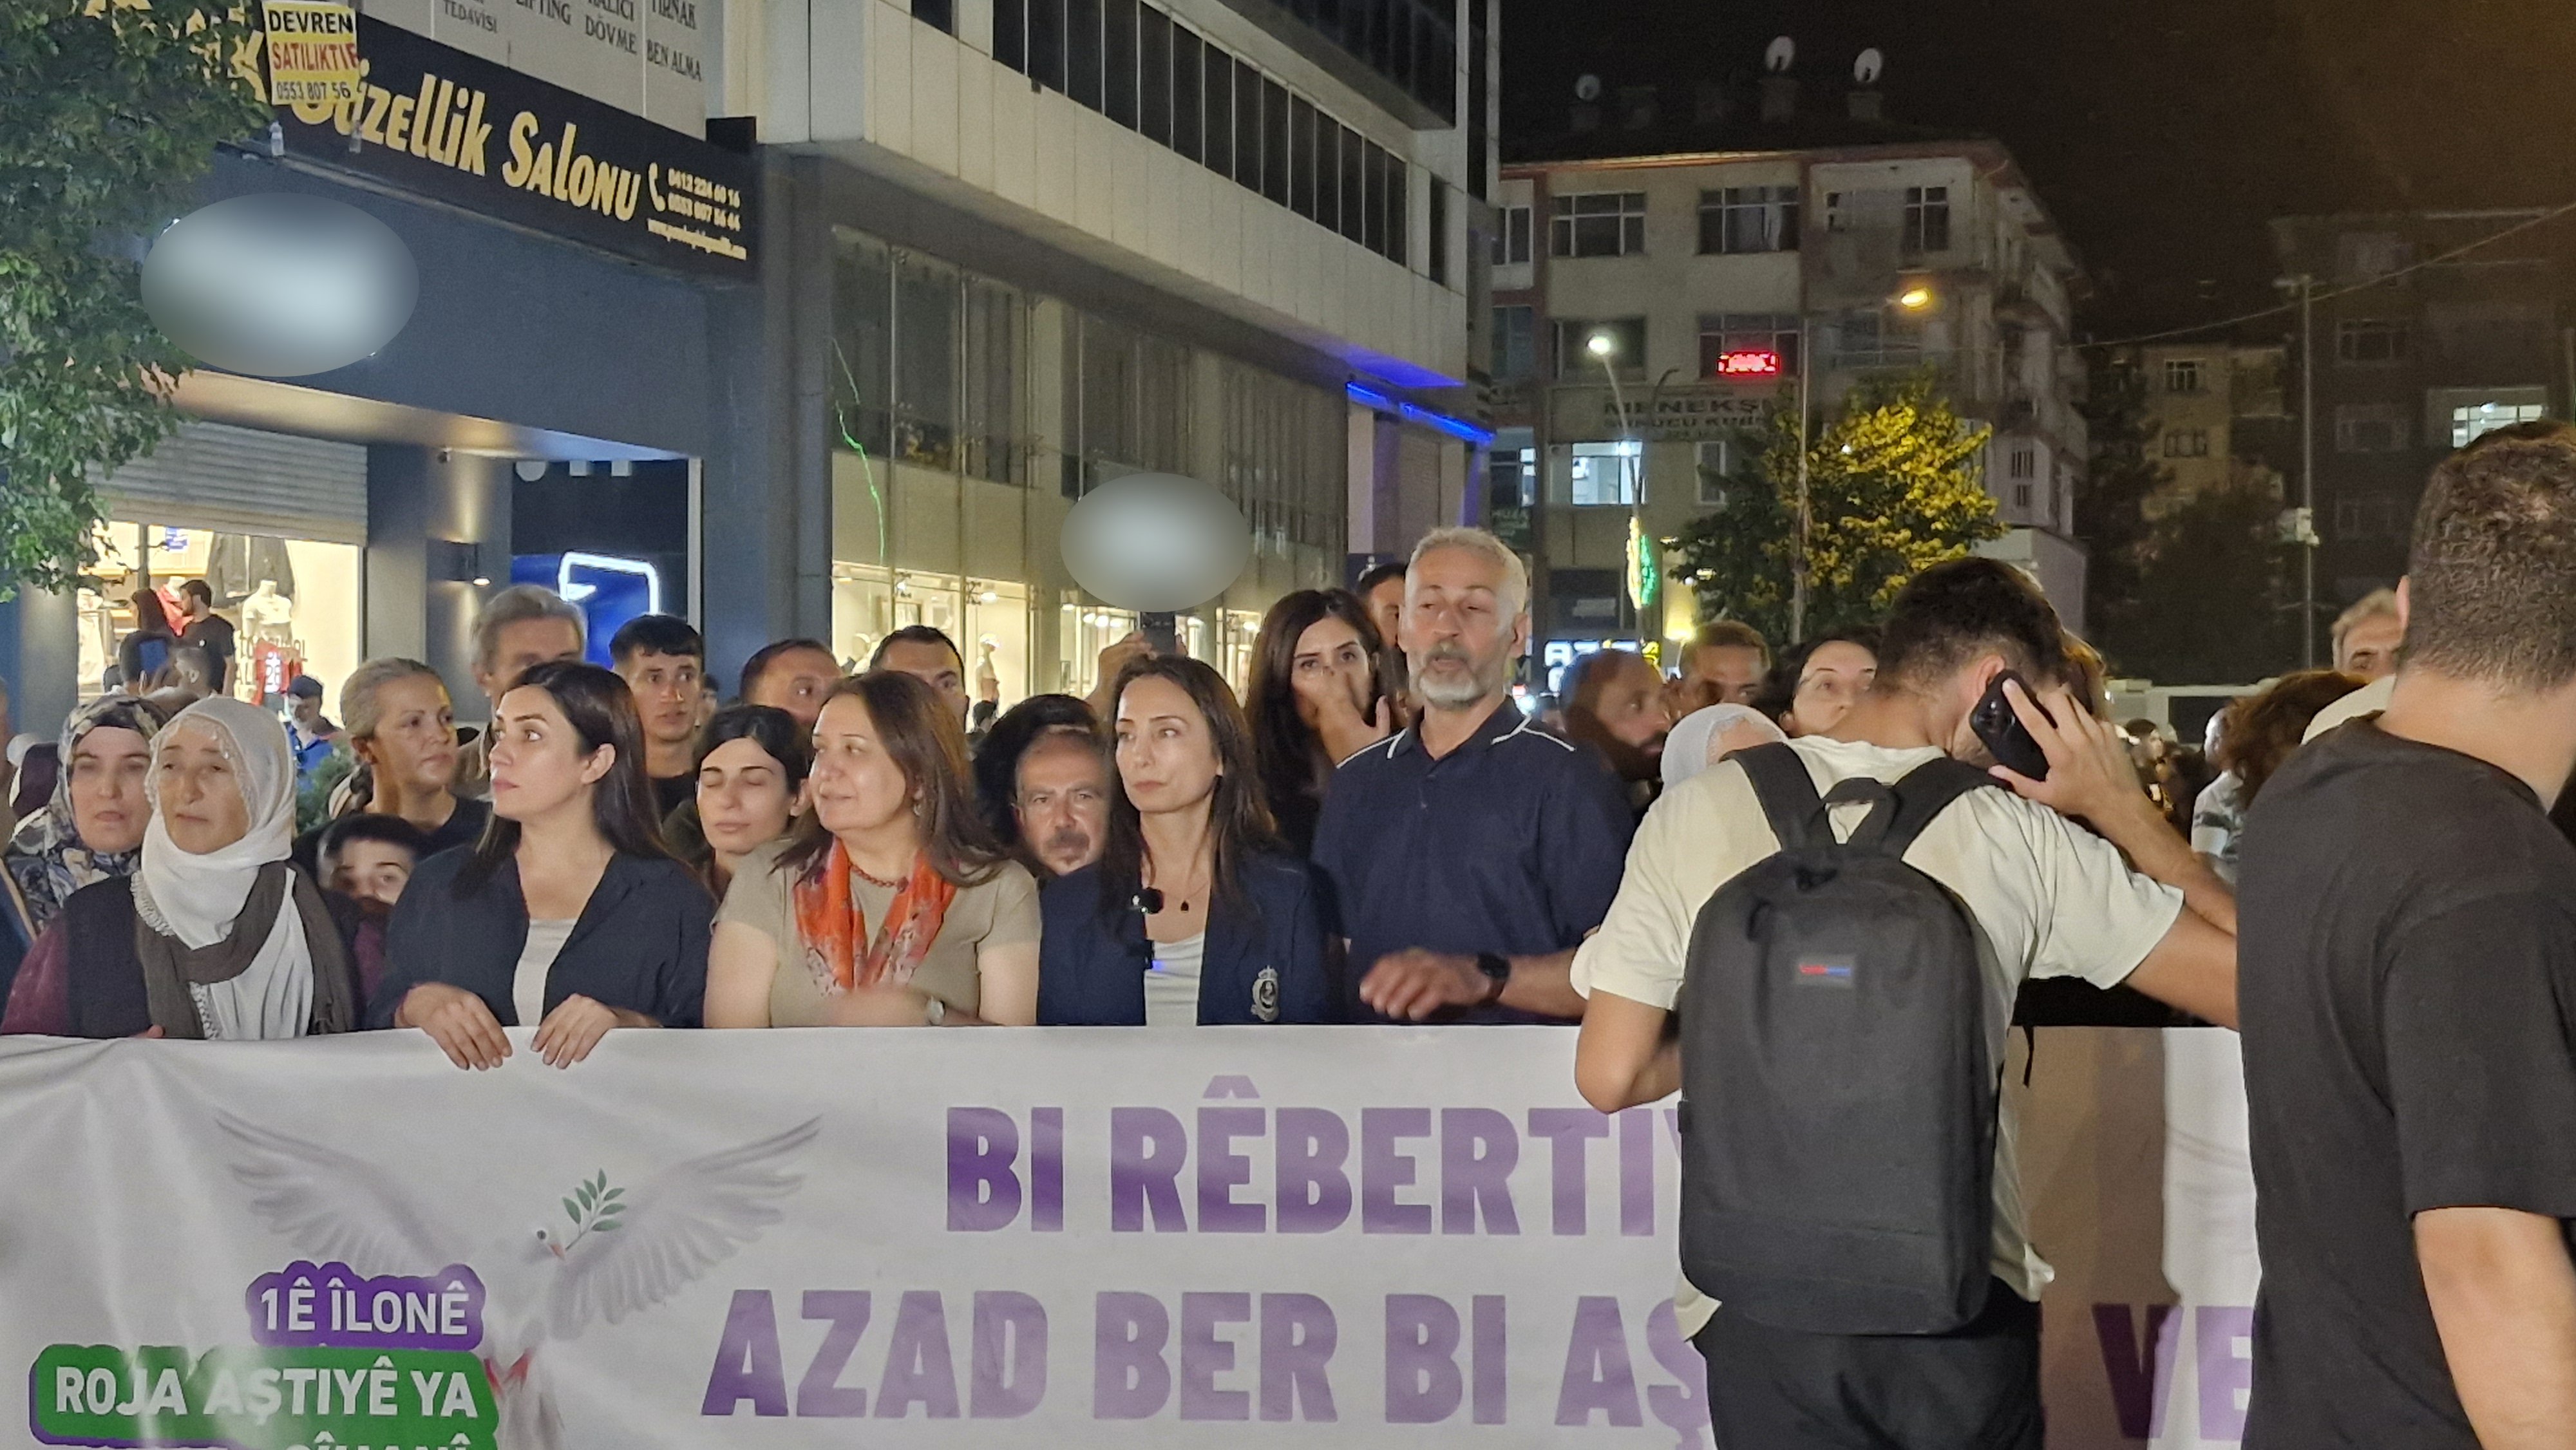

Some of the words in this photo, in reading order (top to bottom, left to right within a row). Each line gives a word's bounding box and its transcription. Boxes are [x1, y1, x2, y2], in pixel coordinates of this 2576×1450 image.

[268, 10, 354, 34] DEVREN
[585, 14, 637, 55] DÖVME
[646, 39, 669, 67] BEN
[670, 50, 702, 82] ALMA
[277, 82, 303, 100] 0553
[307, 82, 327, 100] 807
[332, 81, 352, 100] 56
[947, 1106, 1063, 1232] BI
[1110, 1075, 1681, 1236] RÊBERTI
[261, 1276, 316, 1332] 1Ê
[327, 1277, 469, 1335] ÎLONÊ
[701, 1289, 1048, 1418] AZAD
[1094, 1291, 1339, 1423] BER
[1385, 1294, 1507, 1425] BI
[55, 1366, 188, 1417] ROJA
[411, 1371, 478, 1418] YA
